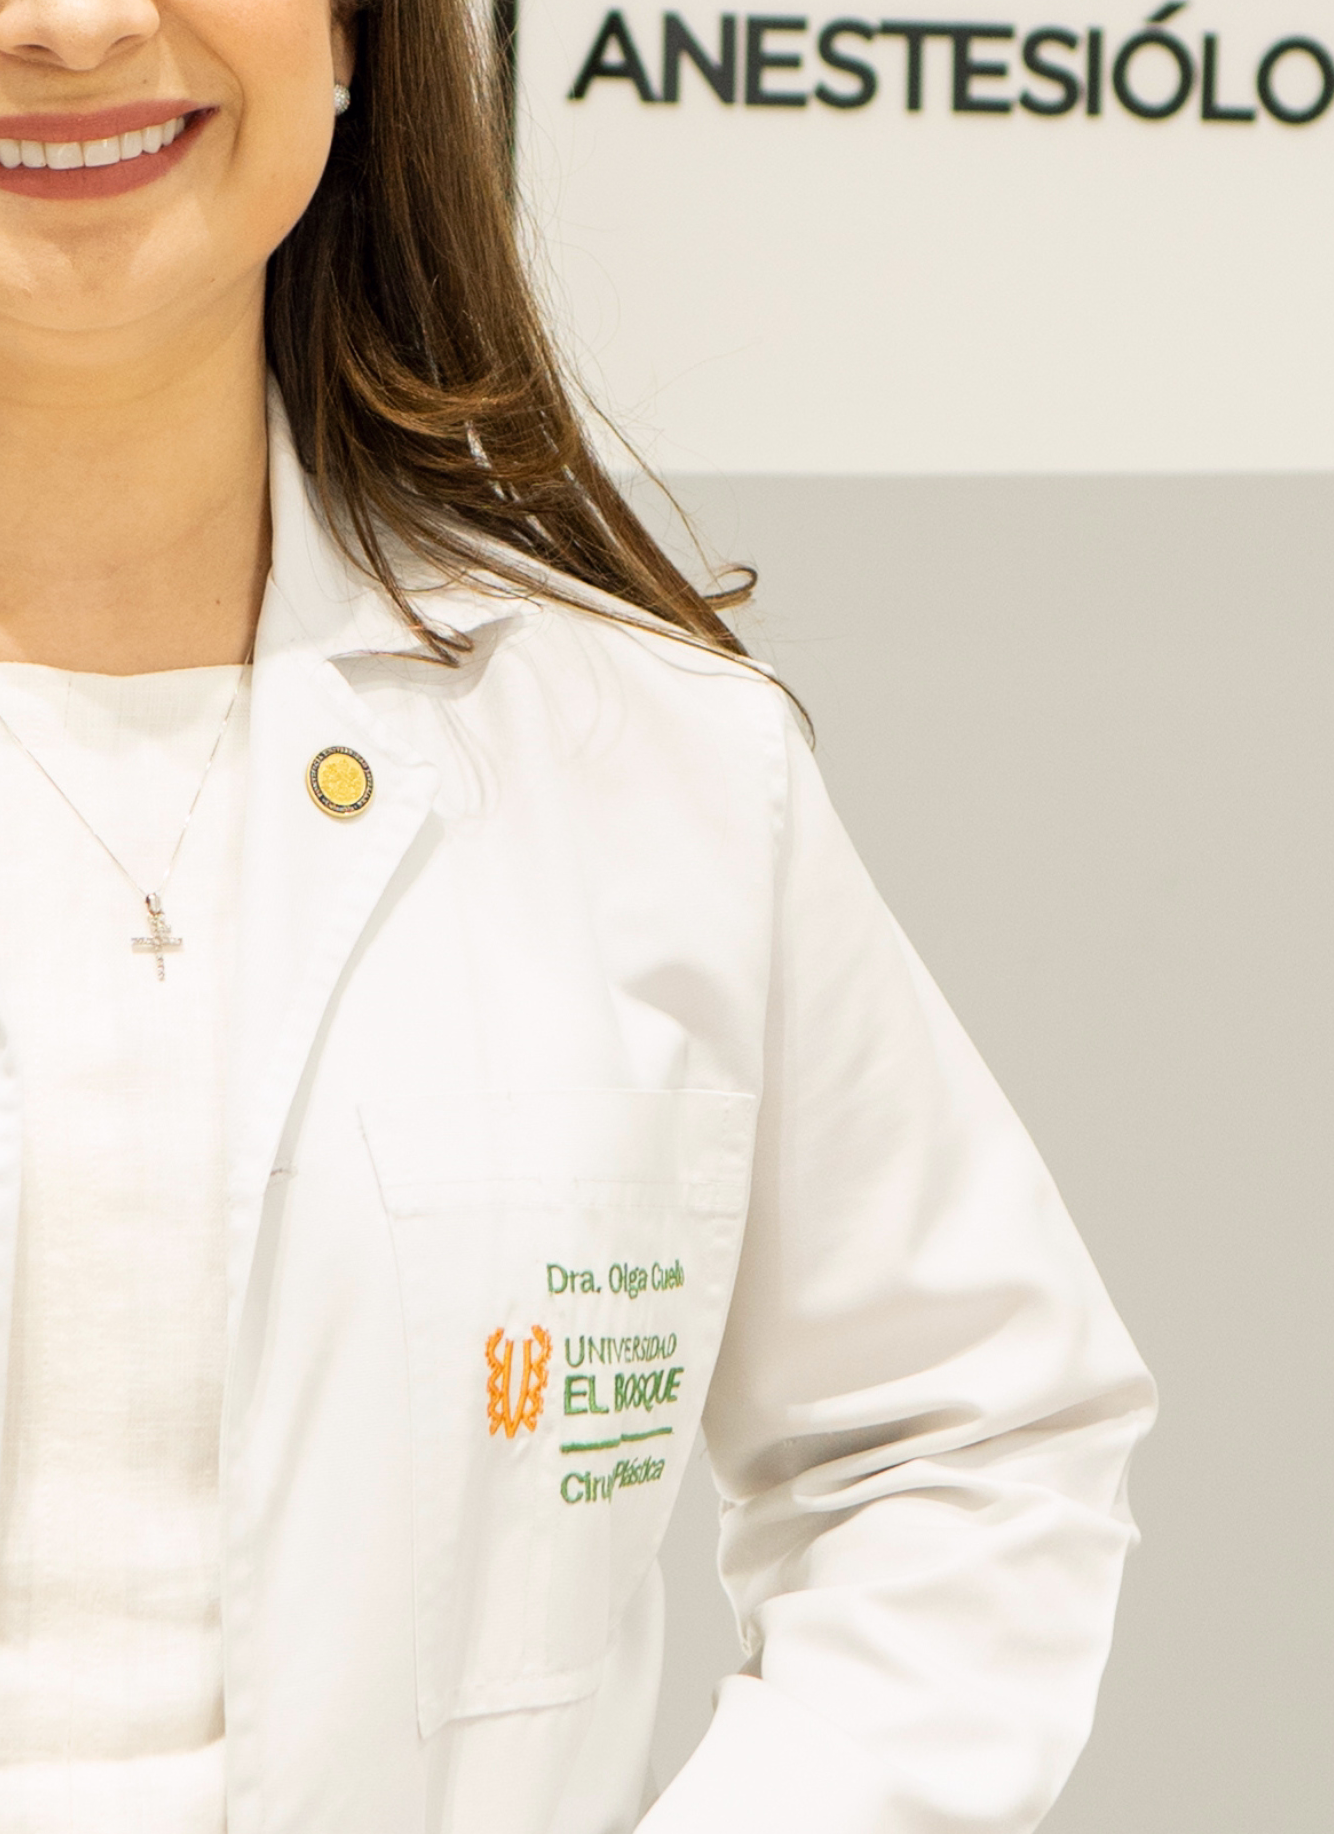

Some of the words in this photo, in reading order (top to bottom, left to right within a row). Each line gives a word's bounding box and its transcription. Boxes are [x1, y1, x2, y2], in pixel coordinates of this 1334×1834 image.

[546, 1262, 602, 1295] Dra.
[608, 1261, 649, 1300] Olga
[563, 1331, 678, 1368] UNIVERSIDAD
[563, 1373, 610, 1416] EL
[614, 1366, 685, 1414] BOSQUE
